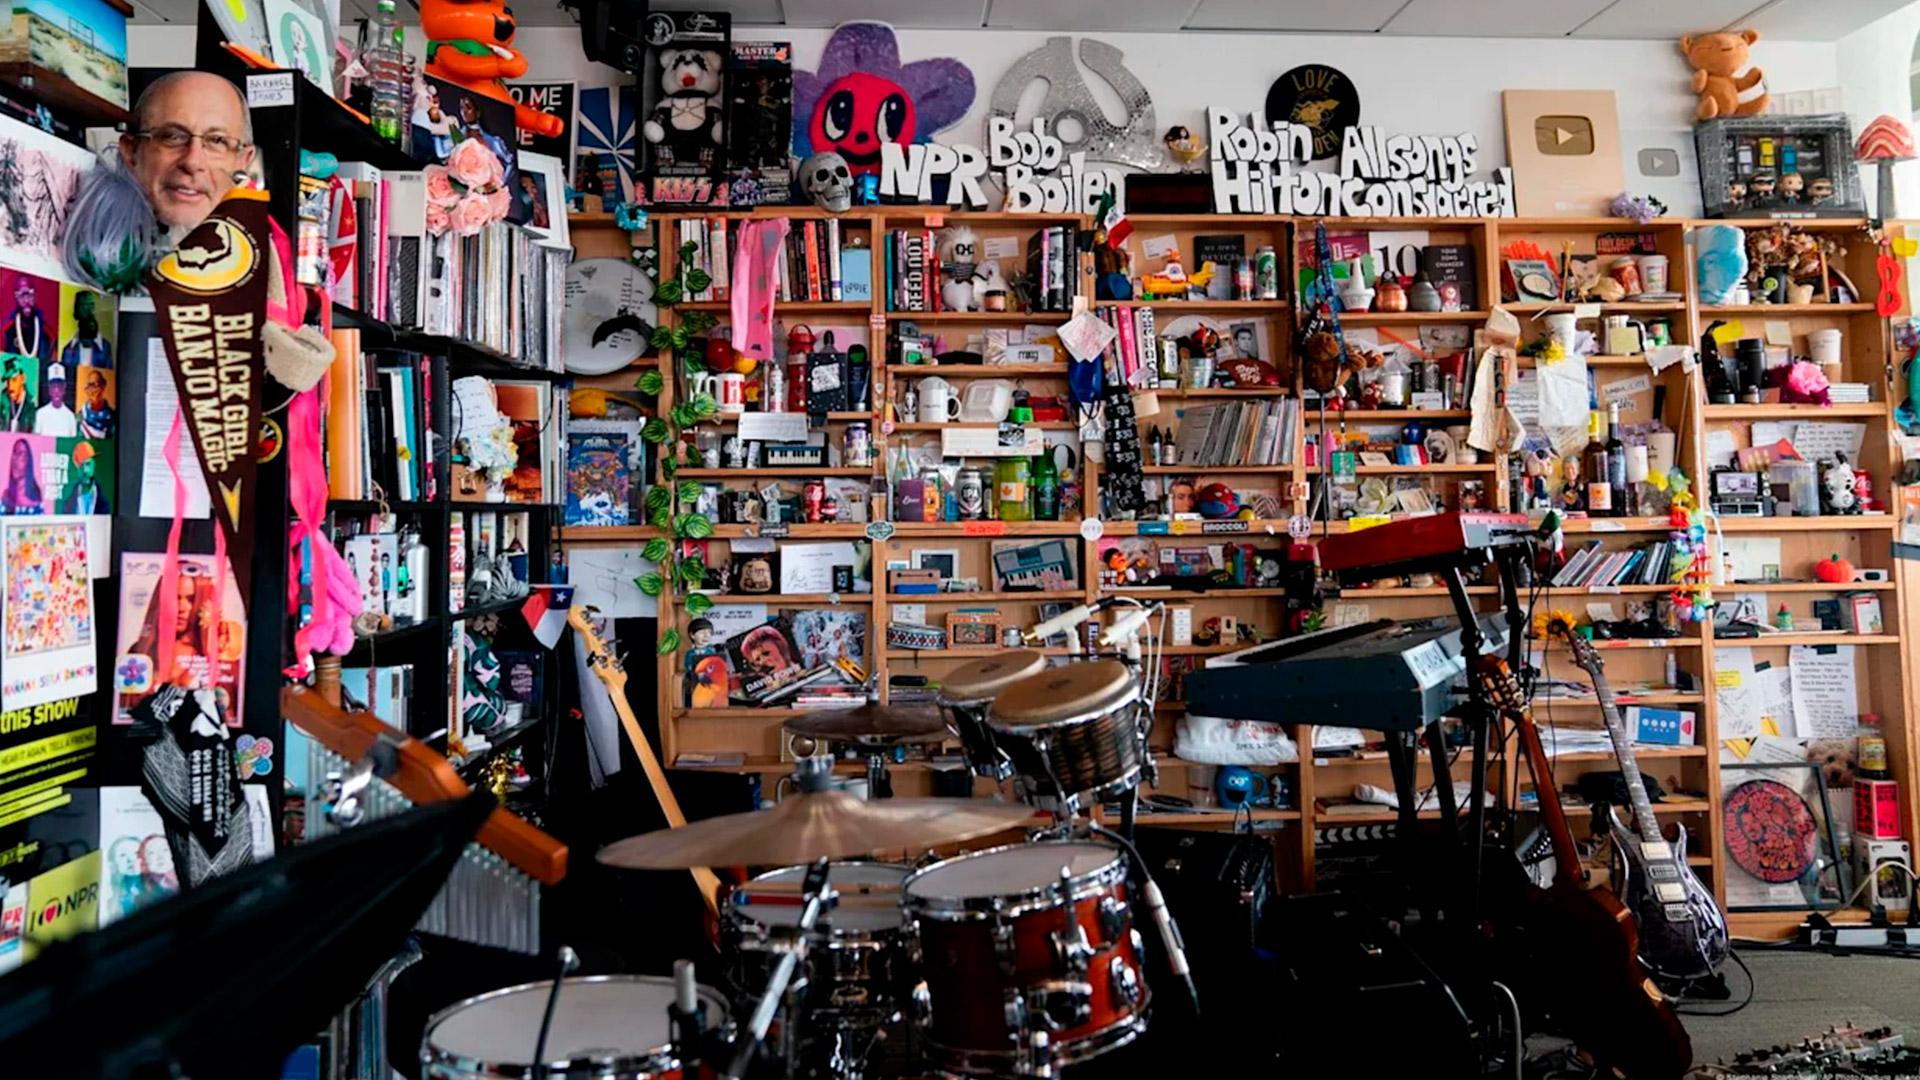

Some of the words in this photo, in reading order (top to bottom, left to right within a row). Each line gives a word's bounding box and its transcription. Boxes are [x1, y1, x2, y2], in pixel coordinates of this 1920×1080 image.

[530, 87, 562, 106] ME
[1291, 69, 1340, 93] LOVE
[989, 117, 1063, 169] Bob
[1207, 106, 1313, 162] Robin
[653, 177, 711, 202] KISS
[879, 142, 989, 207] NPR
[1007, 152, 1126, 213] Boilen
[1212, 158, 1342, 216] Hilton
[908, 271, 923, 311] REED
[168, 304, 217, 395] BANJO
[214, 312, 254, 402] BLACK
[190, 398, 230, 474] MAGIC
[221, 403, 250, 463] GIRL
[1203, 522, 1248, 532] BROCCOLI
[746, 673, 773, 693] DAVID
[0, 707, 31, 734] this
[63, 882, 99, 919] NPR
